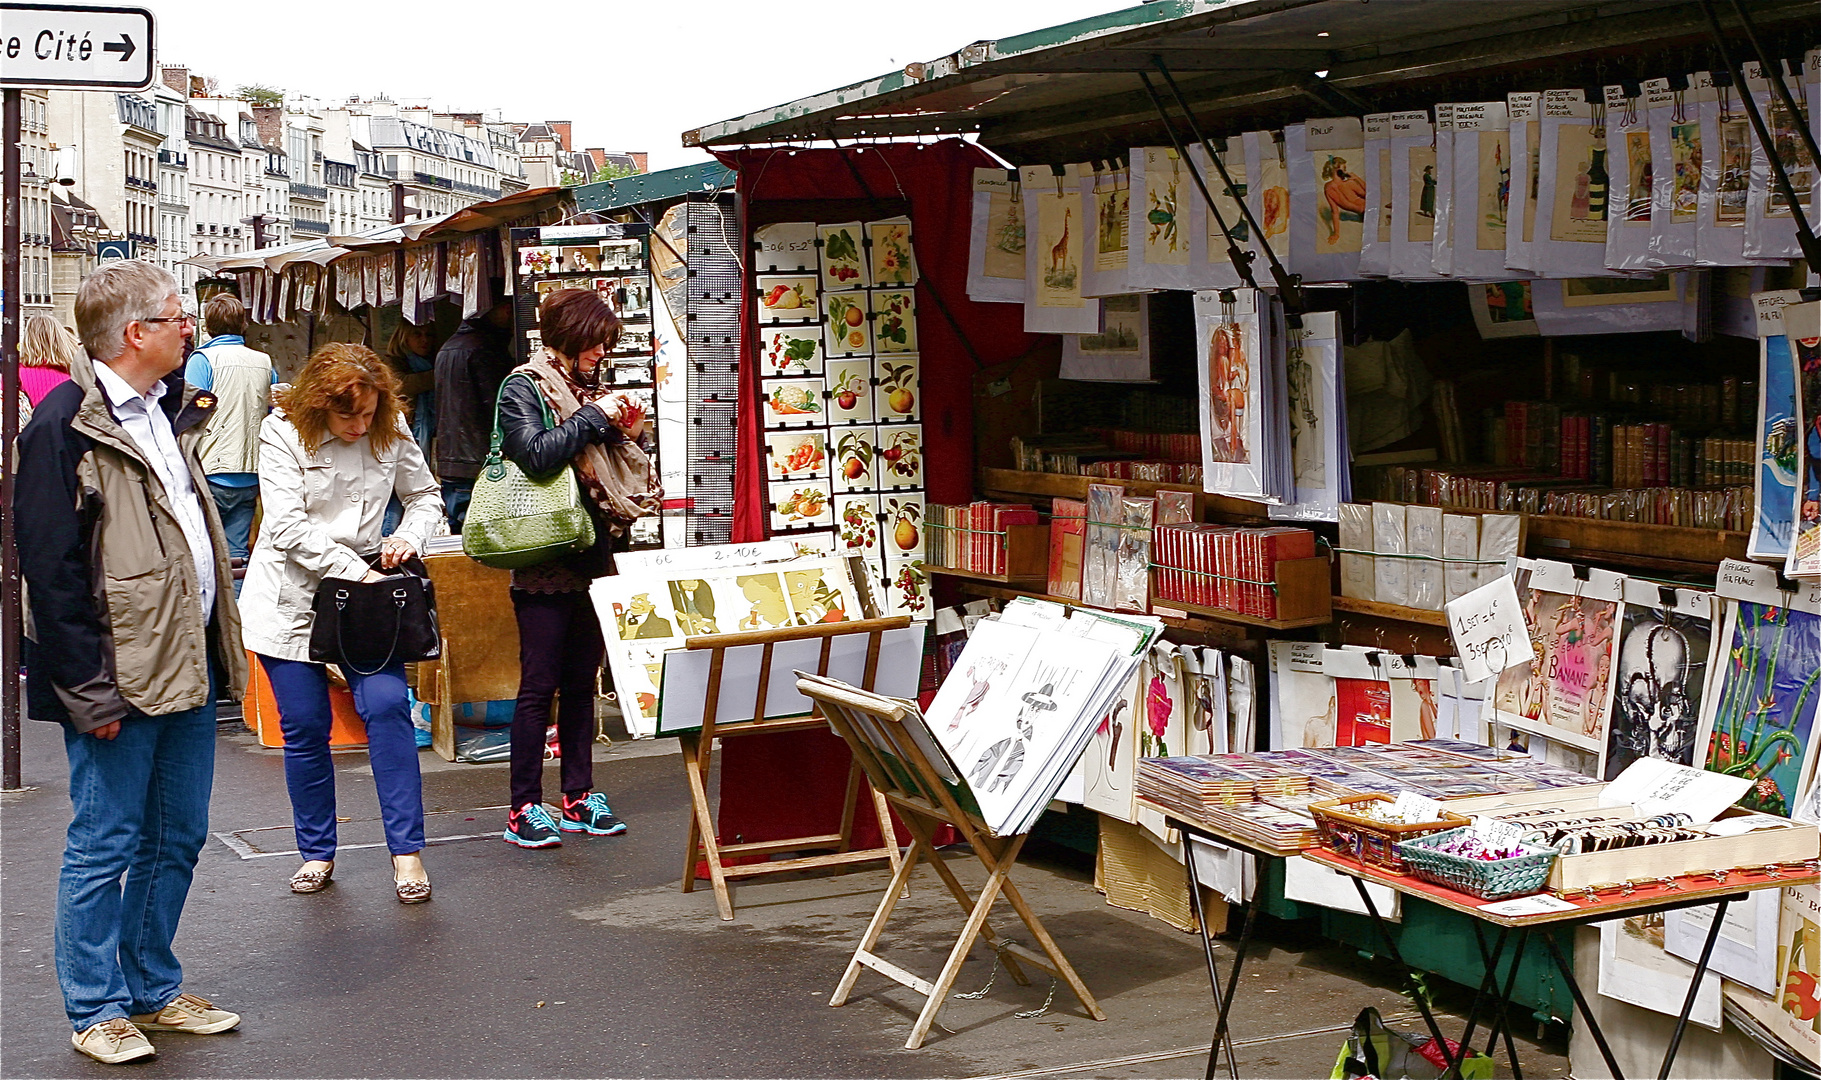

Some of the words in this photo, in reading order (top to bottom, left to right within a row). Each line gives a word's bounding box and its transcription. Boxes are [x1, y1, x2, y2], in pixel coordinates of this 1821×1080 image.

[34, 29, 92, 61] Cité
[1724, 562, 1751, 574] AFFICHES
[1723, 573, 1733, 584] AIR
[1734, 575, 1755, 587] FRANCE
[1574, 655, 1585, 666] LA
[1548, 654, 1590, 688] BANANE
[1787, 886, 1804, 903] DE
